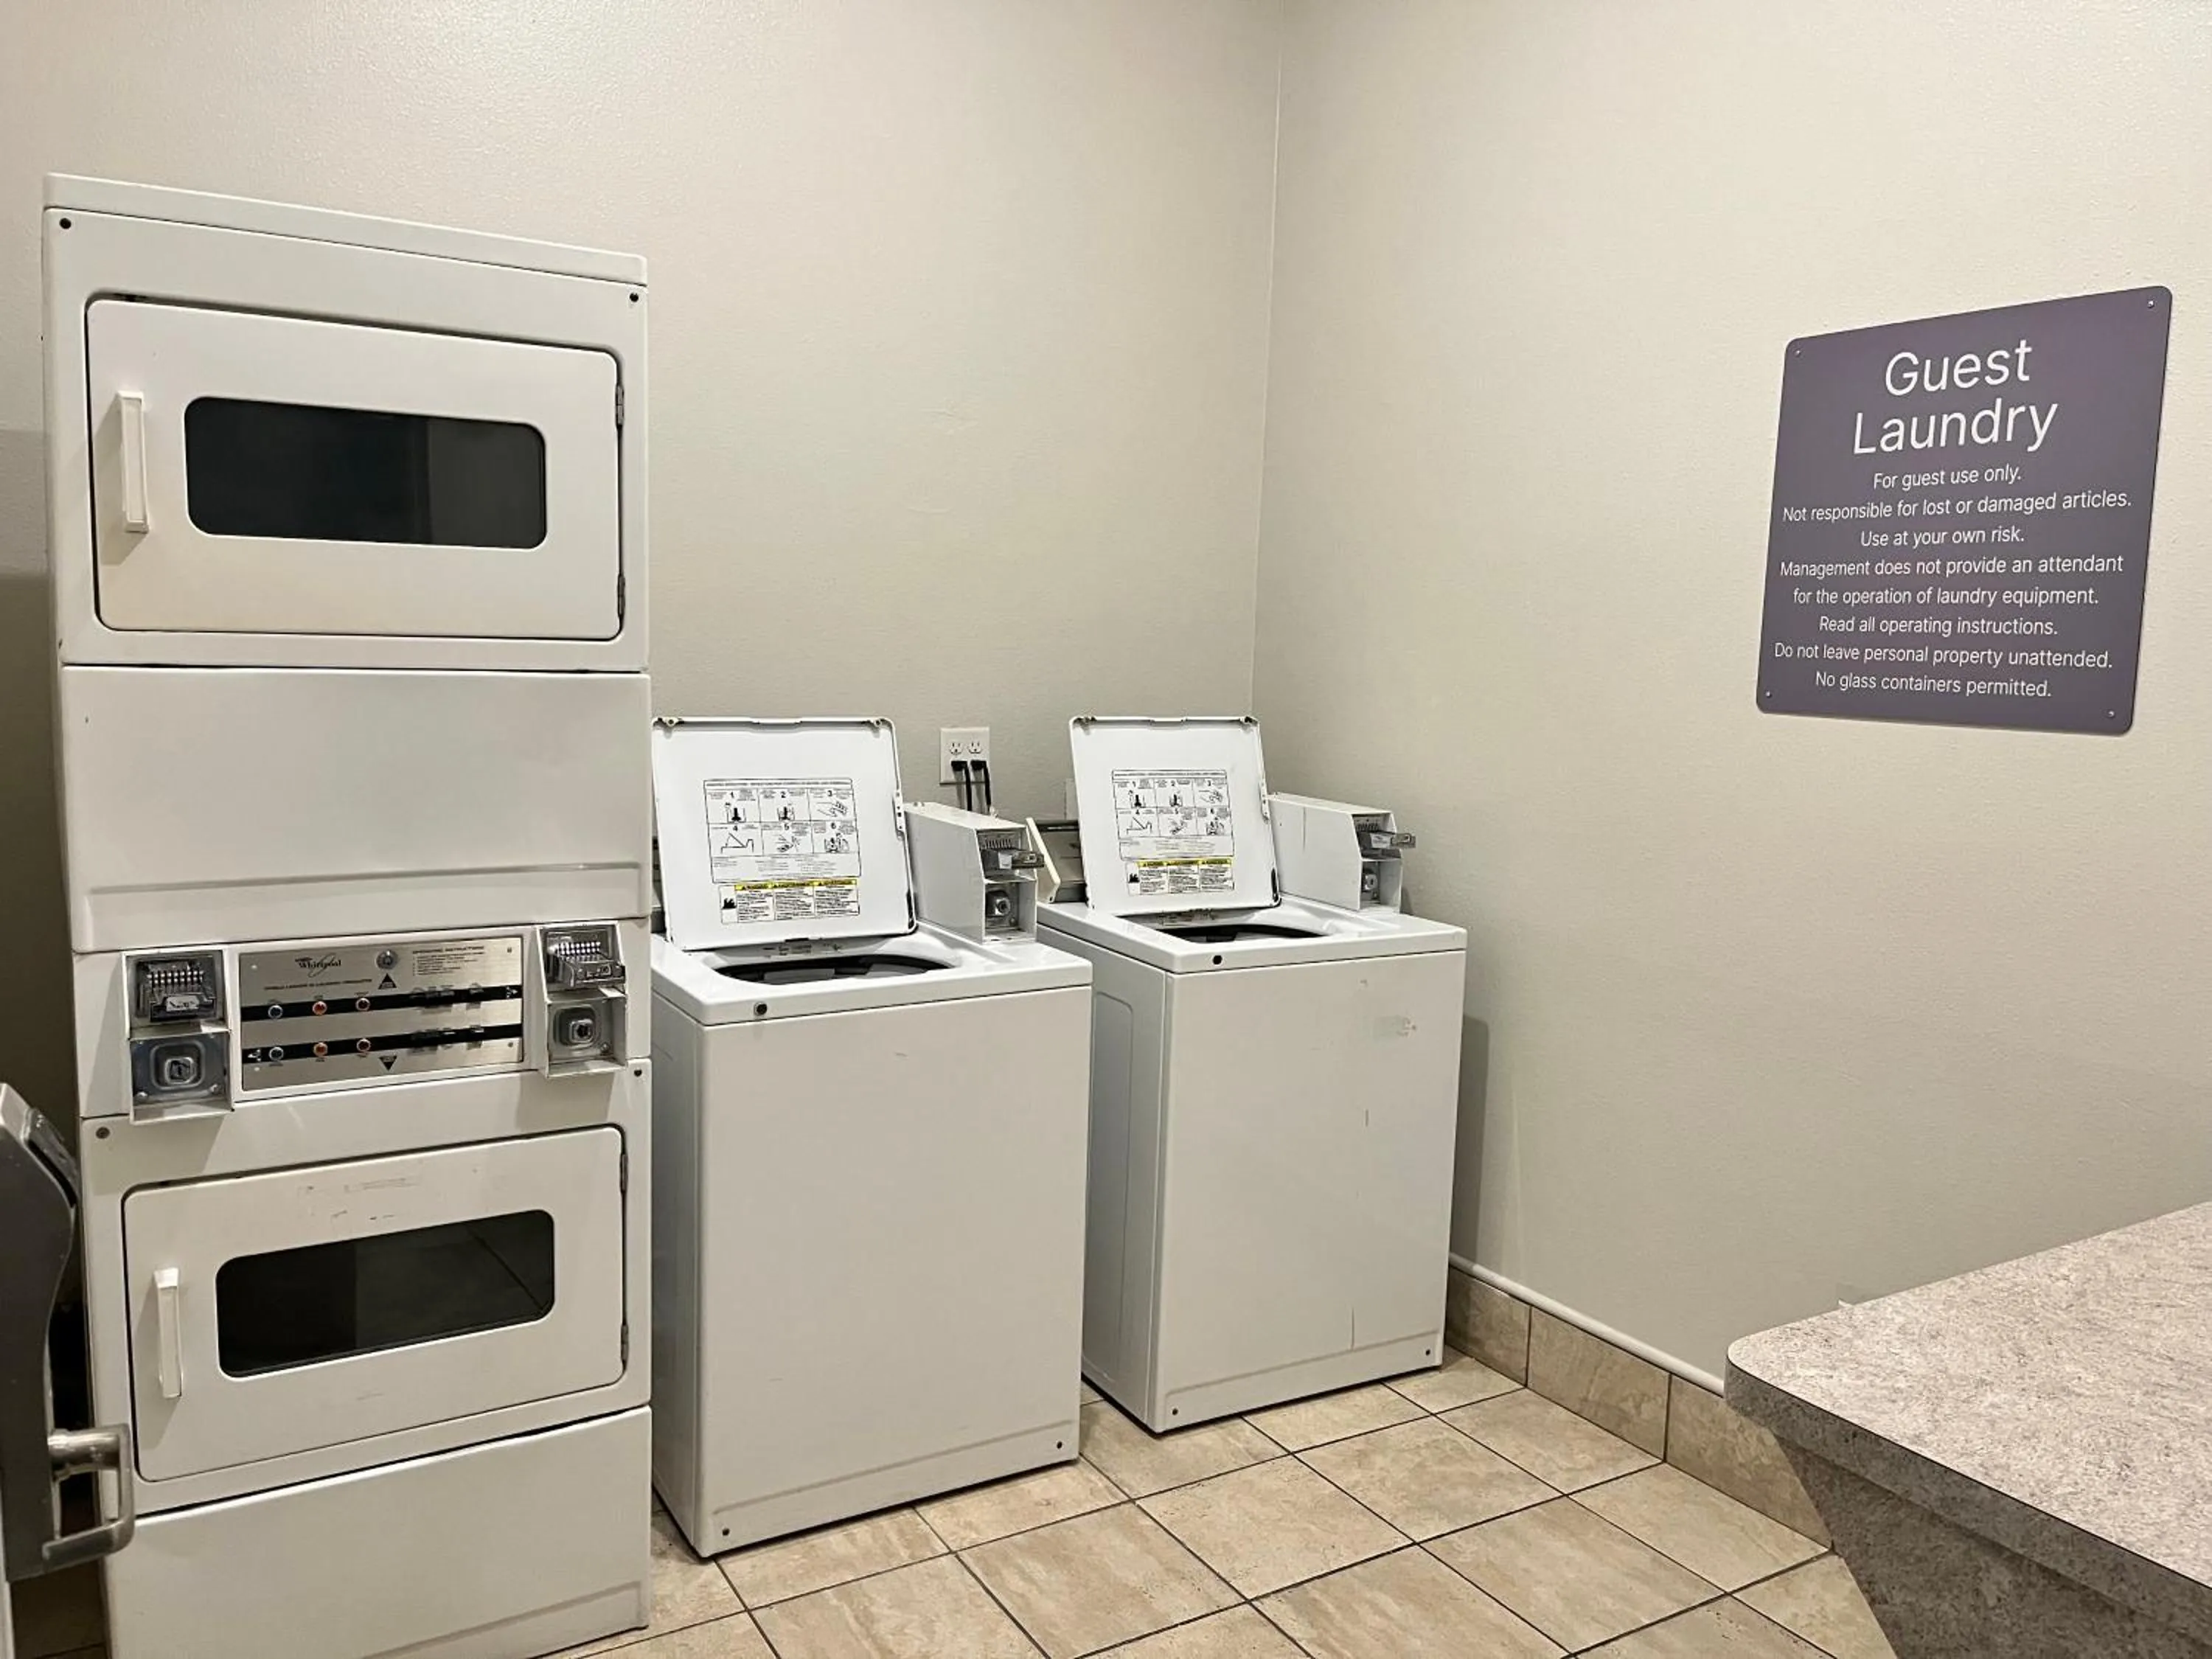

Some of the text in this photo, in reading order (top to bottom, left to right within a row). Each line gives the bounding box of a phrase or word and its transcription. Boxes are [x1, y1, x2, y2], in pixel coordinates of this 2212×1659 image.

[1885, 339, 2033, 396] Guest
[1853, 397, 2059, 455] Laundry
[1874, 462, 2022, 492] For guest use only.
[1782, 490, 2132, 524] Not responsible for lost or damaged articles.
[1860, 525, 2025, 549] Use at your own risk.
[1781, 554, 2124, 580] Management does not provide an attendant
[1793, 586, 2098, 608] for the operation of laundry equipment.
[1819, 616, 2058, 638] Read all operating instructions.
[1775, 642, 2112, 669] Do not leave personal property unattended.
[1815, 671, 2051, 697] No glass containers permitted.
